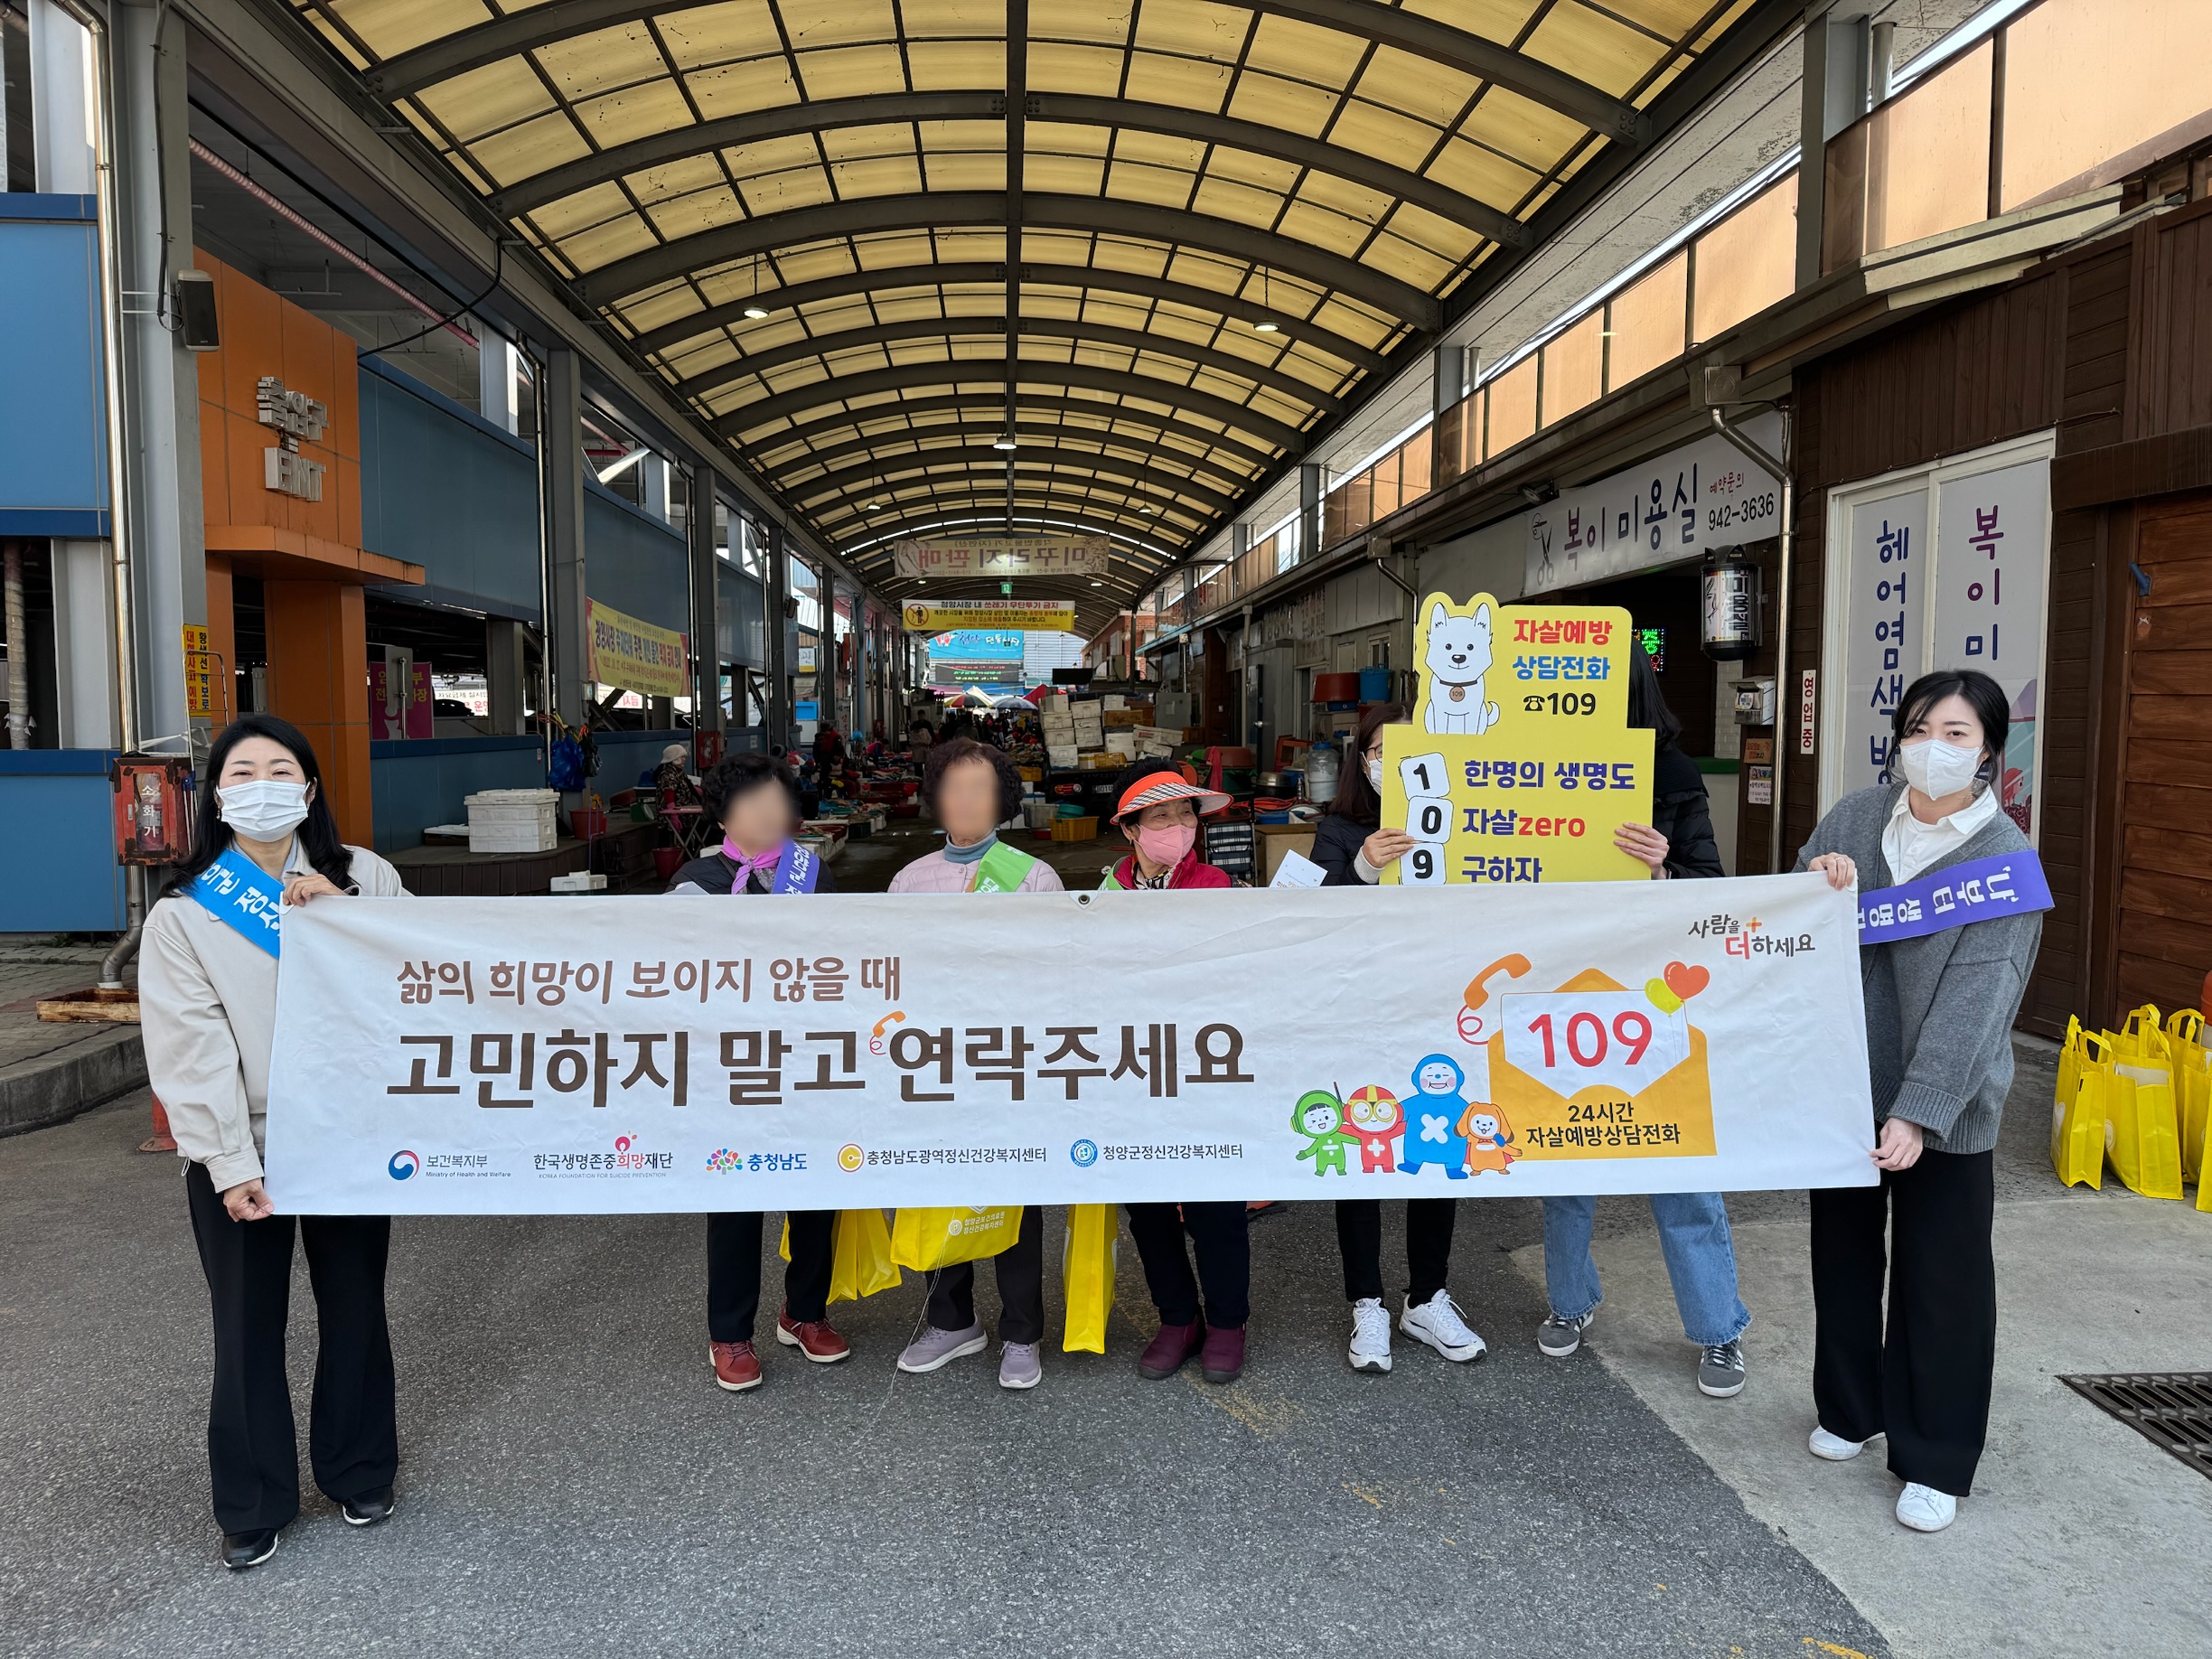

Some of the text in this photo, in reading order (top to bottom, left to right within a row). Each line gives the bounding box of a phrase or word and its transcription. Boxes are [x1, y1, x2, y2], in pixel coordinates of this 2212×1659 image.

[265, 447, 326, 502] ENT
[1710, 472, 1745, 494] 예약문의
[1564, 463, 1698, 571] 복이 미용실
[1709, 492, 1775, 531] 942-3636
[984, 601, 1008, 609] 쓰레기
[1514, 619, 1613, 646] 자살예방
[1512, 655, 1611, 681] 상담전화
[1451, 690, 1464, 698] 109
[1547, 692, 1596, 716] 109
[1803, 678, 1814, 749] 영업중
[1464, 760, 1636, 791] 한명의 생명도
[1462, 808, 1586, 837] 자살zero
[1462, 855, 1542, 884] 구하자
[1688, 914, 1740, 939] 사람을
[1725, 931, 1816, 960] 더하세요
[398, 956, 901, 1006] 삶의 희망이 보이지 않을 때
[1527, 1010, 1653, 1068] 109
[387, 1023, 1254, 1109] 고민하지 말고 연락주세요
[1568, 1101, 1634, 1123] 24시간
[1526, 1123, 1681, 1148] 자살예방상담전화
[426, 1154, 488, 1168] 보건복지부
[533, 1151, 673, 1170] 한국생명존중희망재단
[747, 1152, 807, 1172] 충청남도
[867, 1147, 1047, 1167] 충청남도광역정신건강복지센터
[1102, 1143, 1243, 1161] 청양군정신건강복지센터
